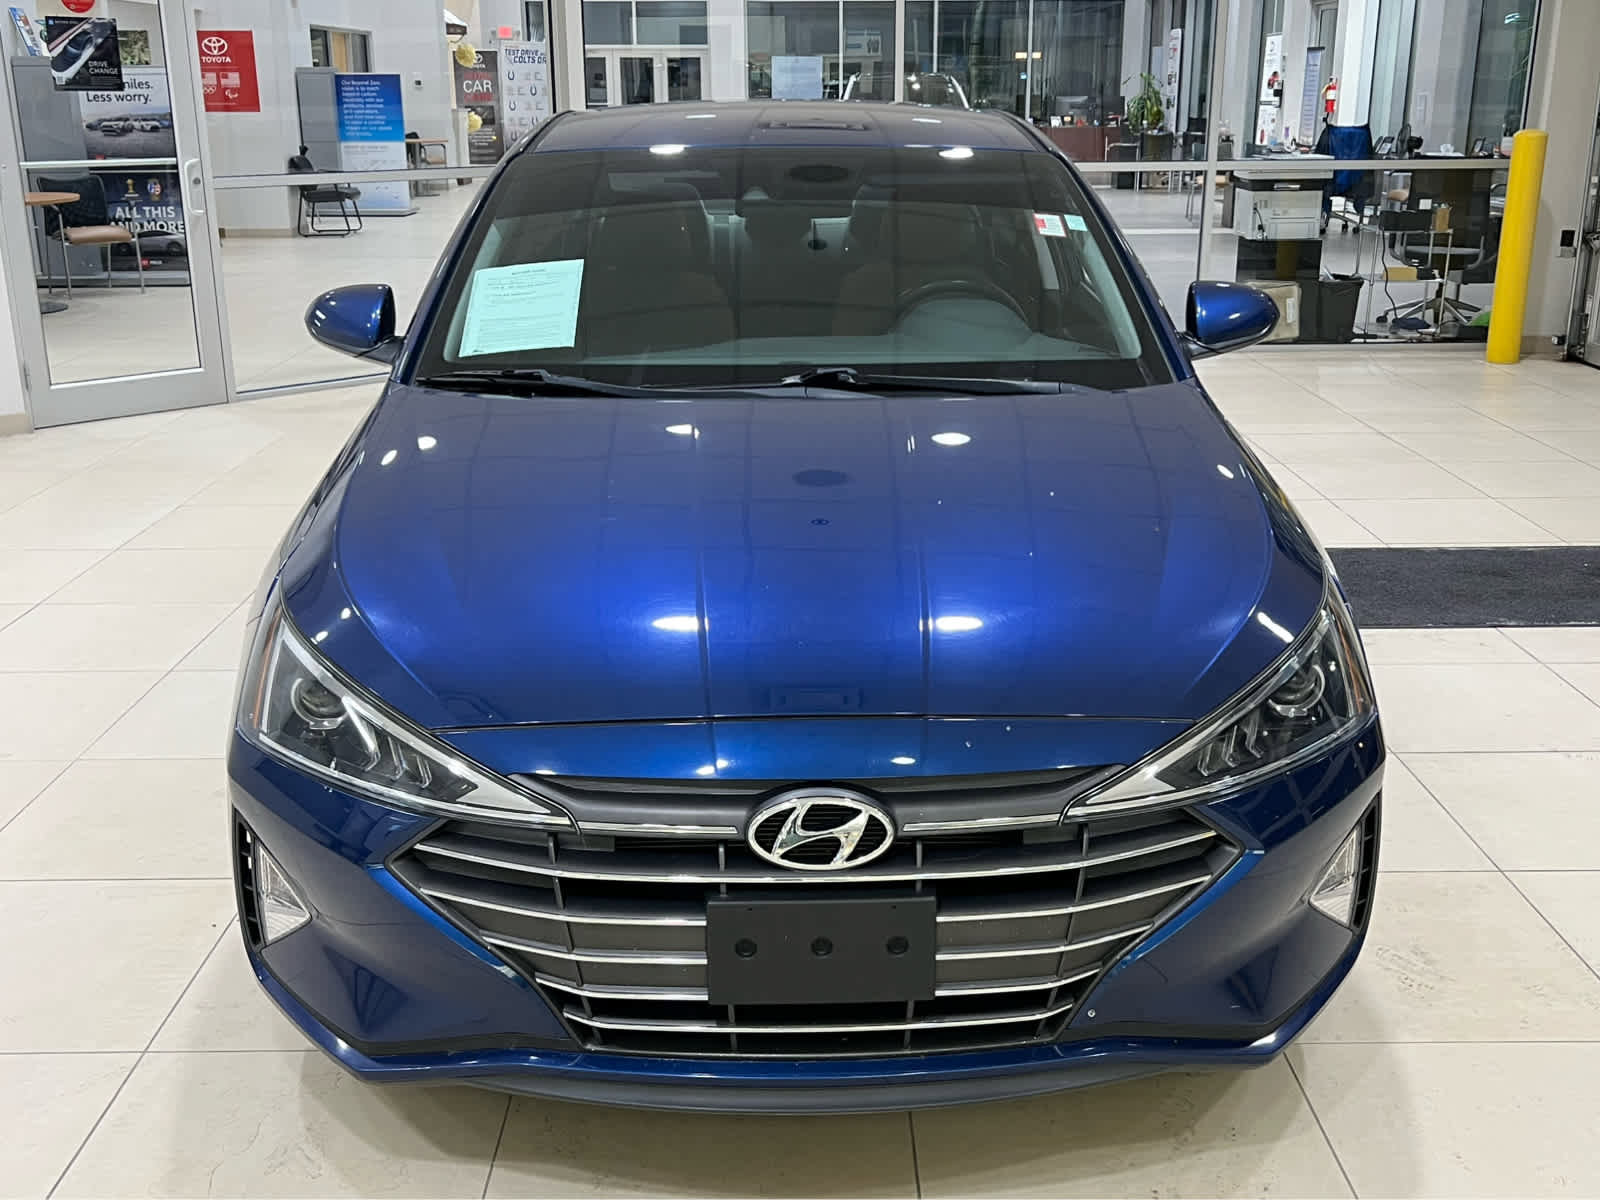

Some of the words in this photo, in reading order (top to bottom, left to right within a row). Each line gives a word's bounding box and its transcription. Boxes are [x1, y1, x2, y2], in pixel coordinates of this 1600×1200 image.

[504, 48, 520, 56] TEST
[513, 56, 536, 64] COLTS
[463, 80, 493, 93] CAR
[86, 92, 112, 103] Less
[113, 93, 152, 104] worry.
[115, 206, 142, 219] ALL
[142, 206, 175, 218] THIS
[143, 221, 185, 233] MORE
